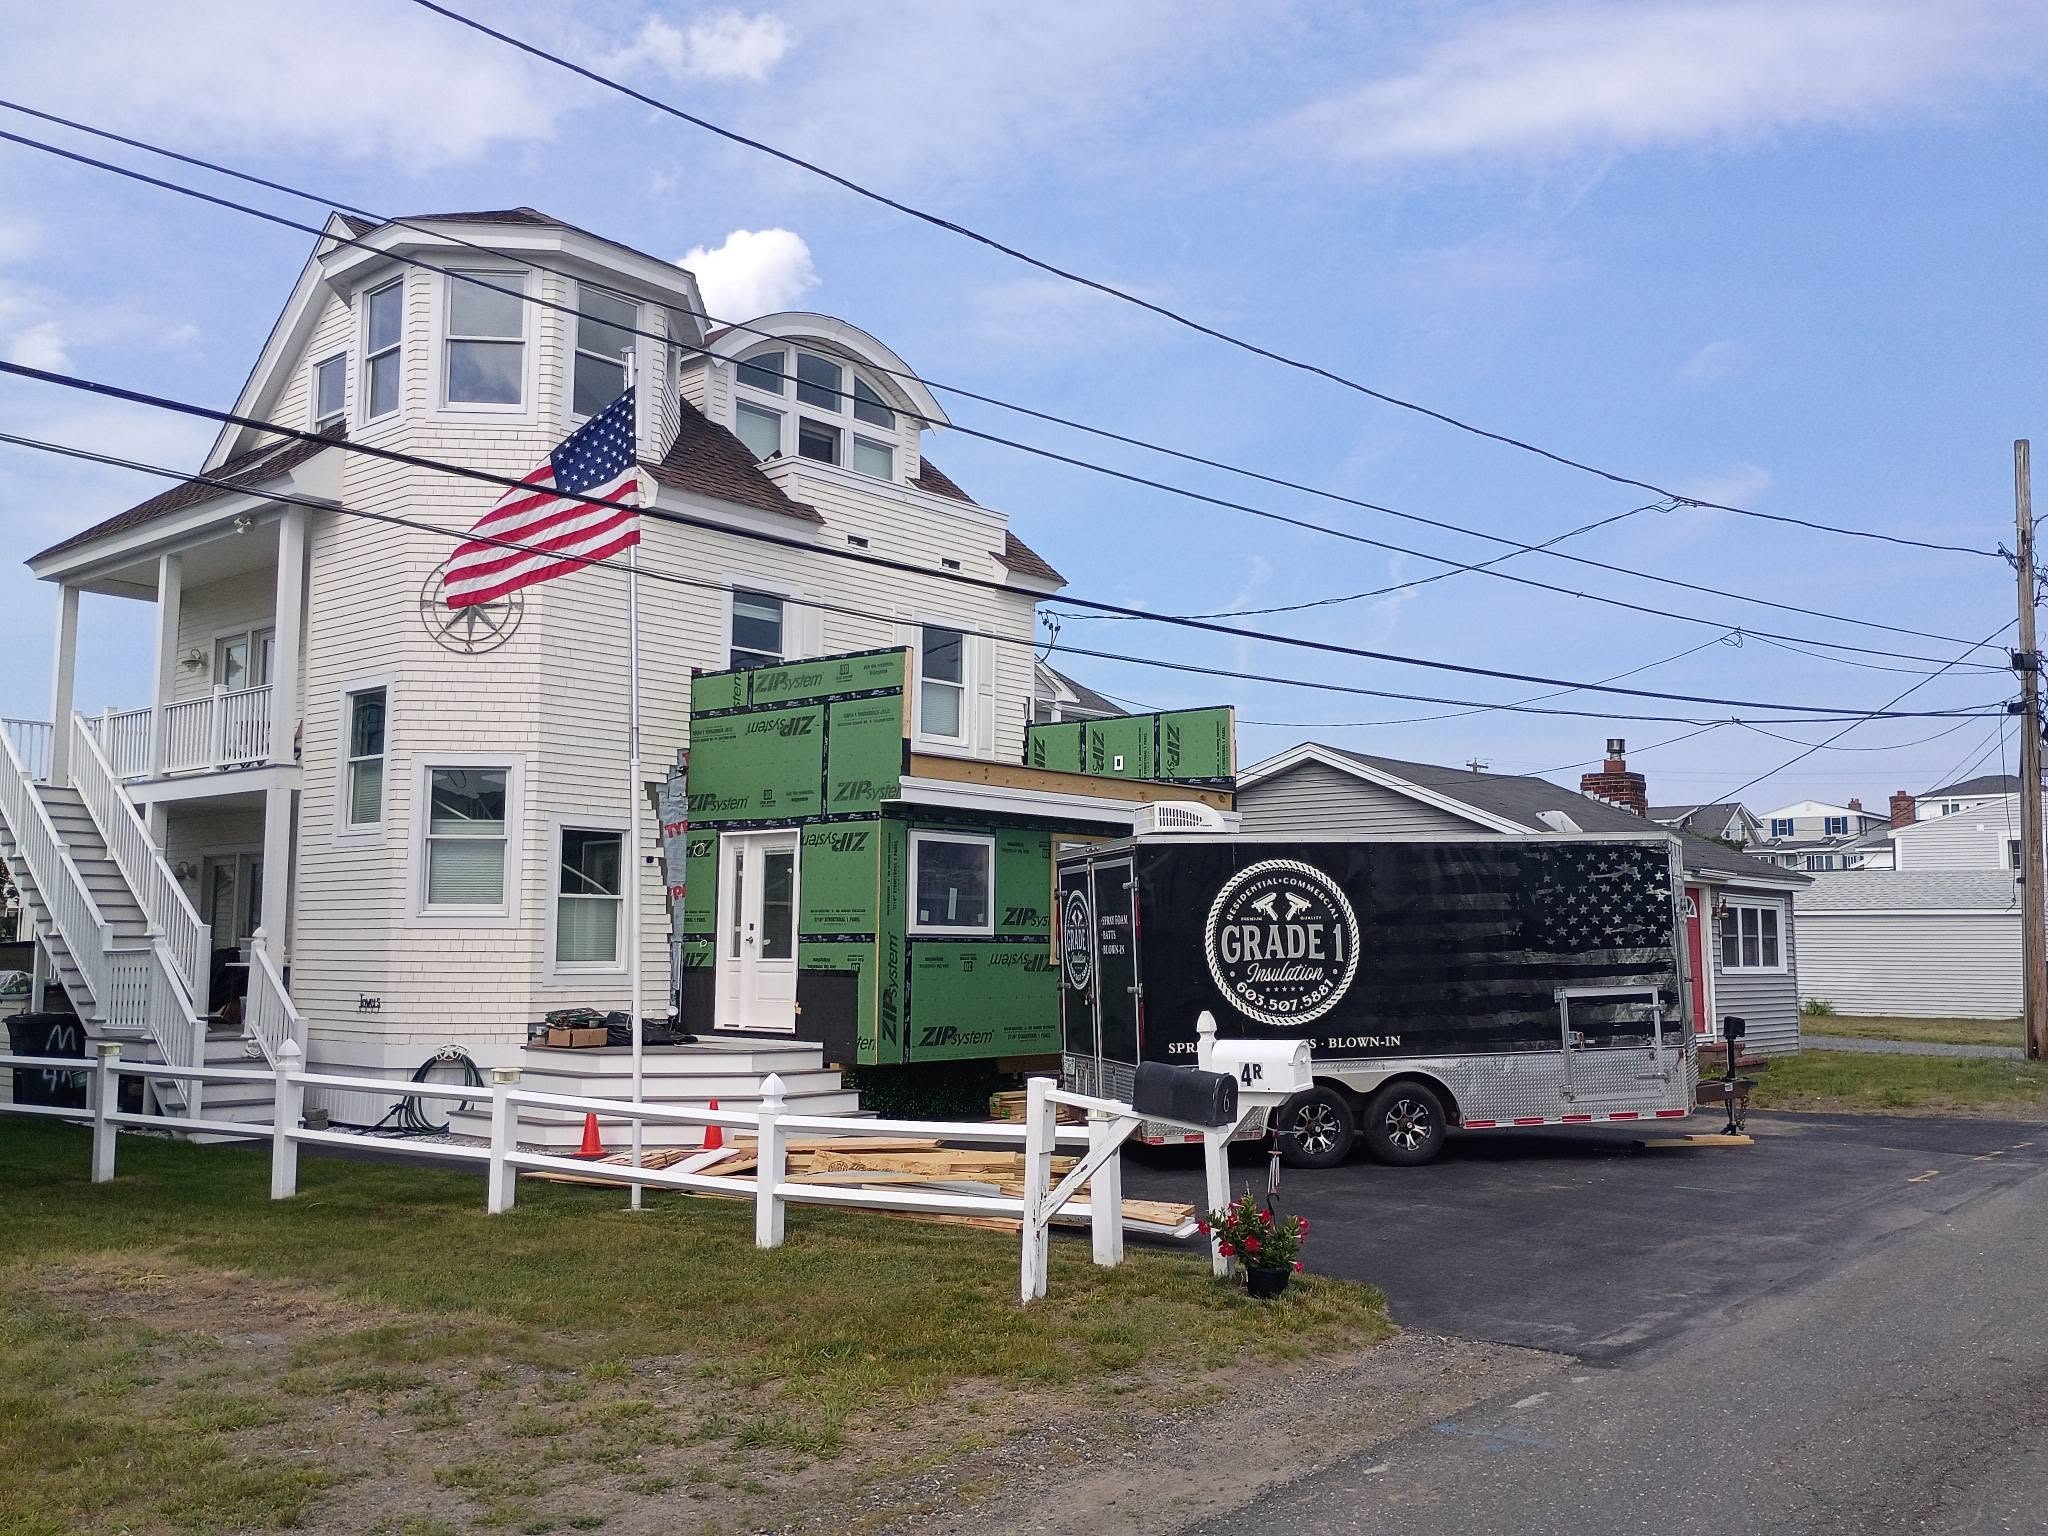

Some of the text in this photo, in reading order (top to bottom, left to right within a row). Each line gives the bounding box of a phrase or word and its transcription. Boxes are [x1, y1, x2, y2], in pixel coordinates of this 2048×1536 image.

[1221, 923, 1344, 963] GRADE 1
[1246, 960, 1325, 983] Insulation
[1236, 978, 1334, 1011] 603.507.5881
[45, 1024, 77, 1051] M
[1328, 1036, 1400, 1049] BLOWN-IN
